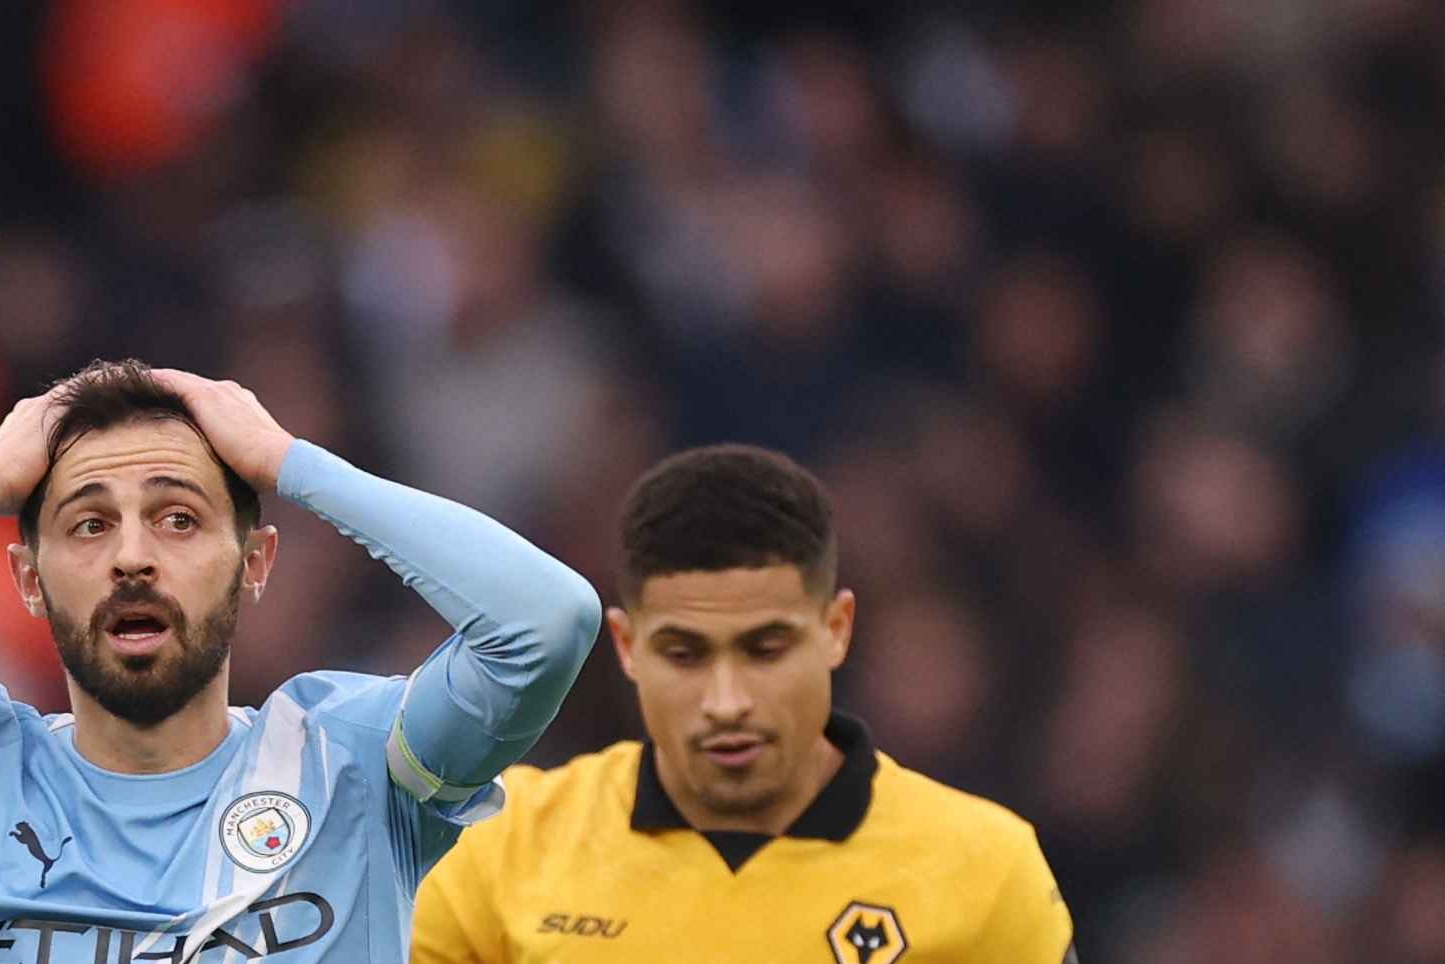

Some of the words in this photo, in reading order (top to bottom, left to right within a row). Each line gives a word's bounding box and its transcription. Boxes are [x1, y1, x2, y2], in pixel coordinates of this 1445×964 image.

[226, 797, 291, 836] MANCHESTER
[271, 848, 294, 866] CITY
[536, 912, 629, 939] SUDU
